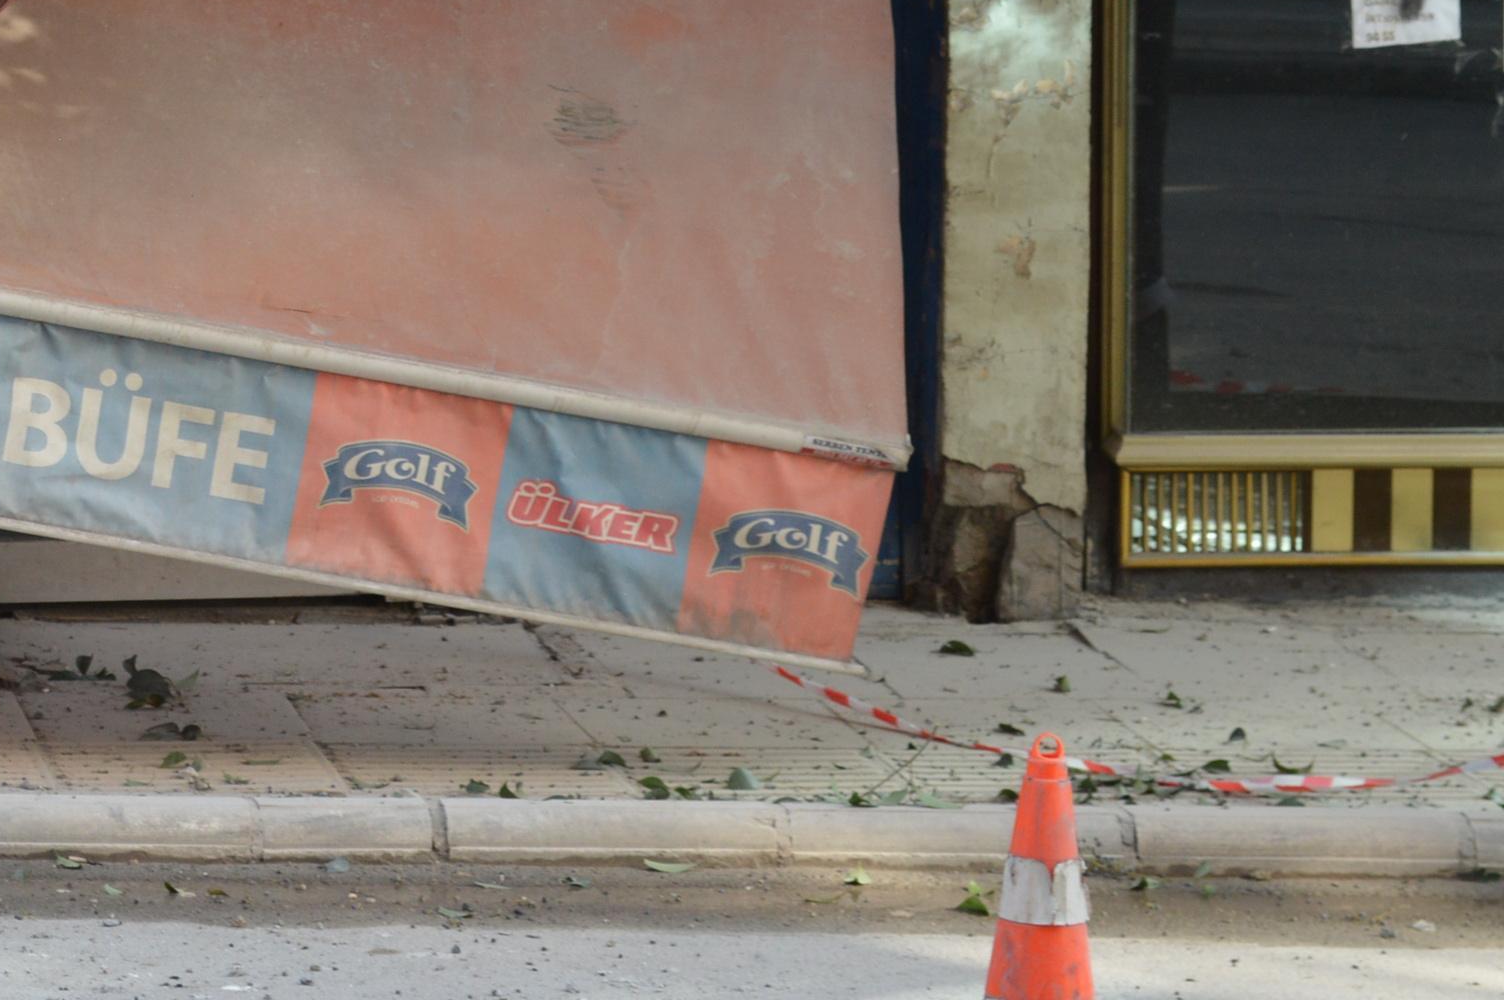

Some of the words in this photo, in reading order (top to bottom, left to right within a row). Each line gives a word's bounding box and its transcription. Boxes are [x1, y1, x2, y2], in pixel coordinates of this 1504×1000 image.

[1, 367, 277, 506] BÜFE
[343, 447, 456, 497] Golf
[506, 479, 682, 555] ÜLKER
[733, 518, 848, 564] Golf
